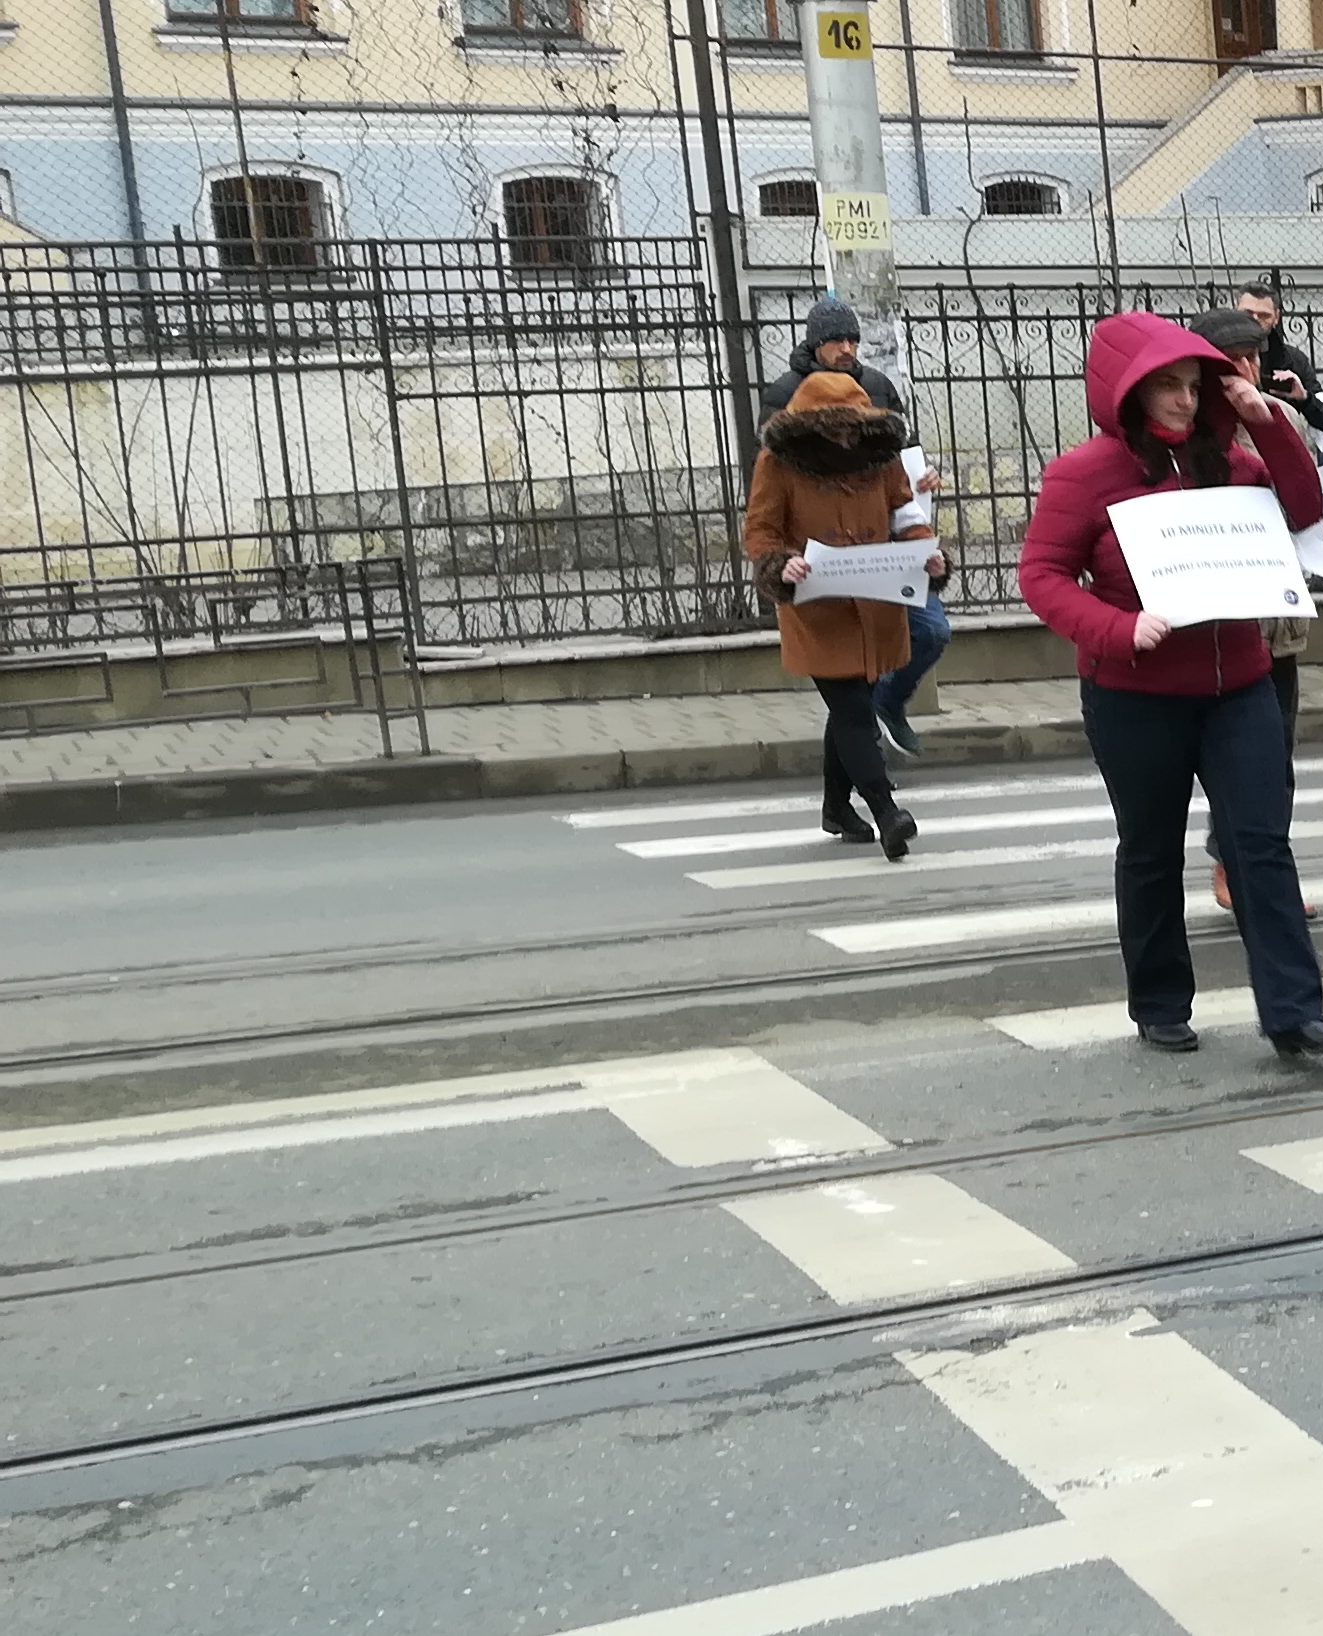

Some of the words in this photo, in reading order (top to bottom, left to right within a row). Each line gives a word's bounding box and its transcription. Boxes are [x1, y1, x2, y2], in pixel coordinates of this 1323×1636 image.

[828, 20, 862, 50] 16
[836, 200, 871, 218] PMI
[825, 220, 888, 240] 270921
[1160, 526, 1176, 539] 10
[1179, 523, 1226, 537] MINUTE
[1230, 522, 1267, 534] ACUM
